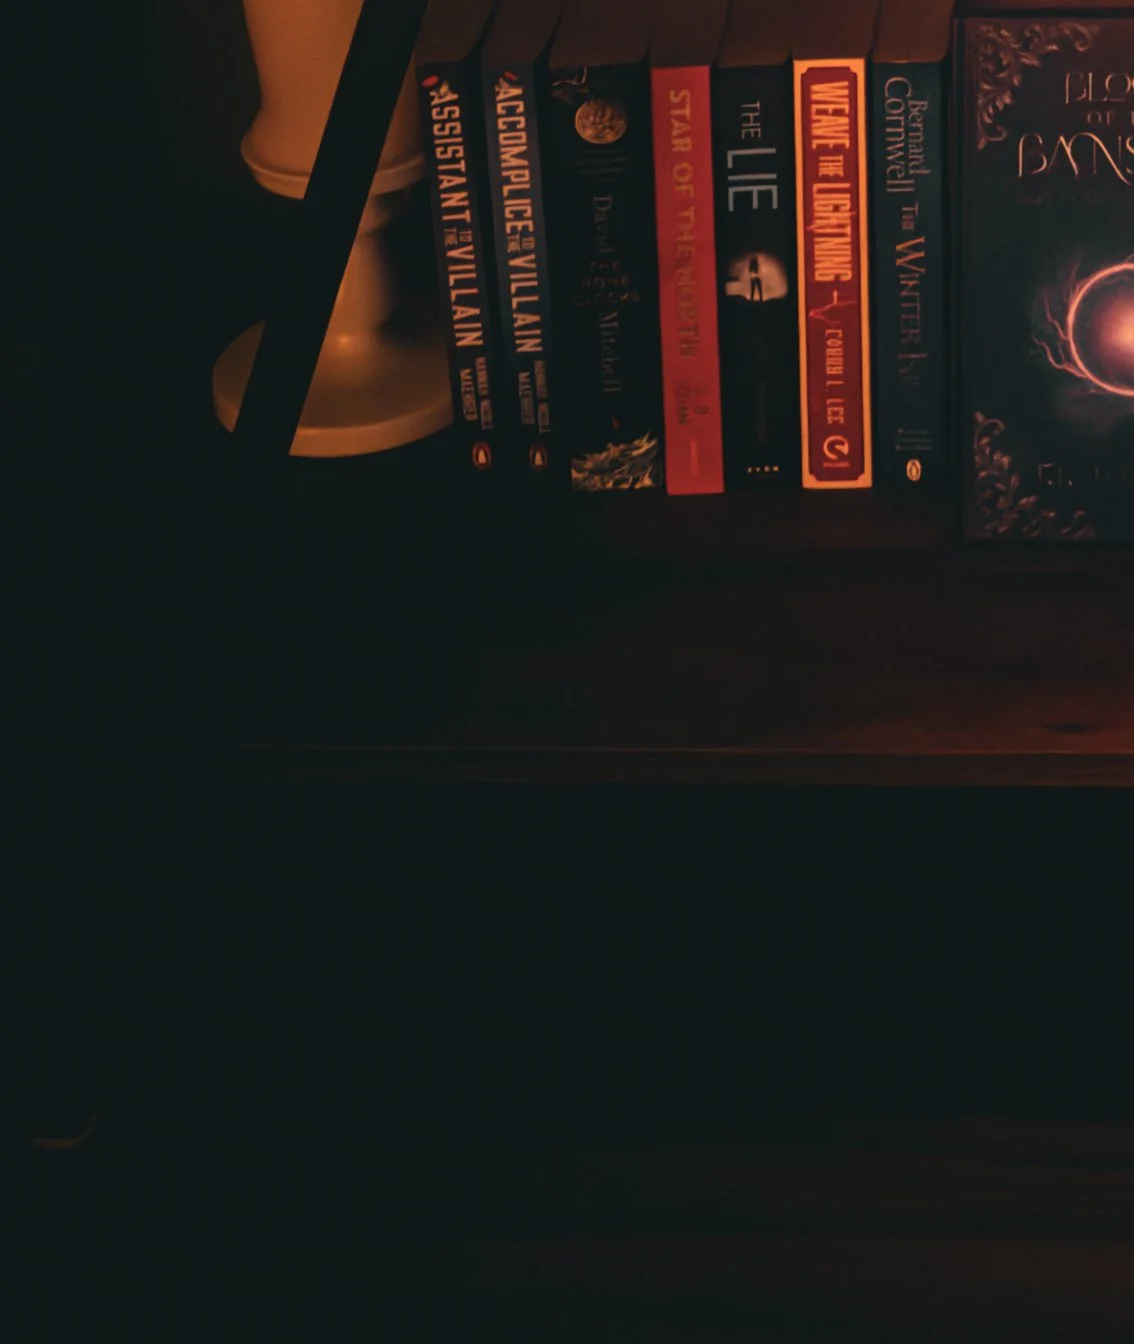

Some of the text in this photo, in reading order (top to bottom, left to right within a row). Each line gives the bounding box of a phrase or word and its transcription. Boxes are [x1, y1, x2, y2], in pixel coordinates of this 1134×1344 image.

[669, 88, 693, 152] STAR
[883, 75, 915, 193] Cornwell
[907, 100, 932, 175] Bernard
[1086, 110, 1114, 126] OF
[672, 162, 695, 197] OF
[726, 100, 778, 212] THE LIE
[809, 81, 853, 282] WEAVE THE LIGHTNING
[429, 91, 484, 348] ASSISTANT TO THE VILLAIN
[495, 85, 543, 353] ACCOMPLICE TO THE VILLAIN
[673, 207, 695, 256] THE
[825, 398, 844, 425] LEE
